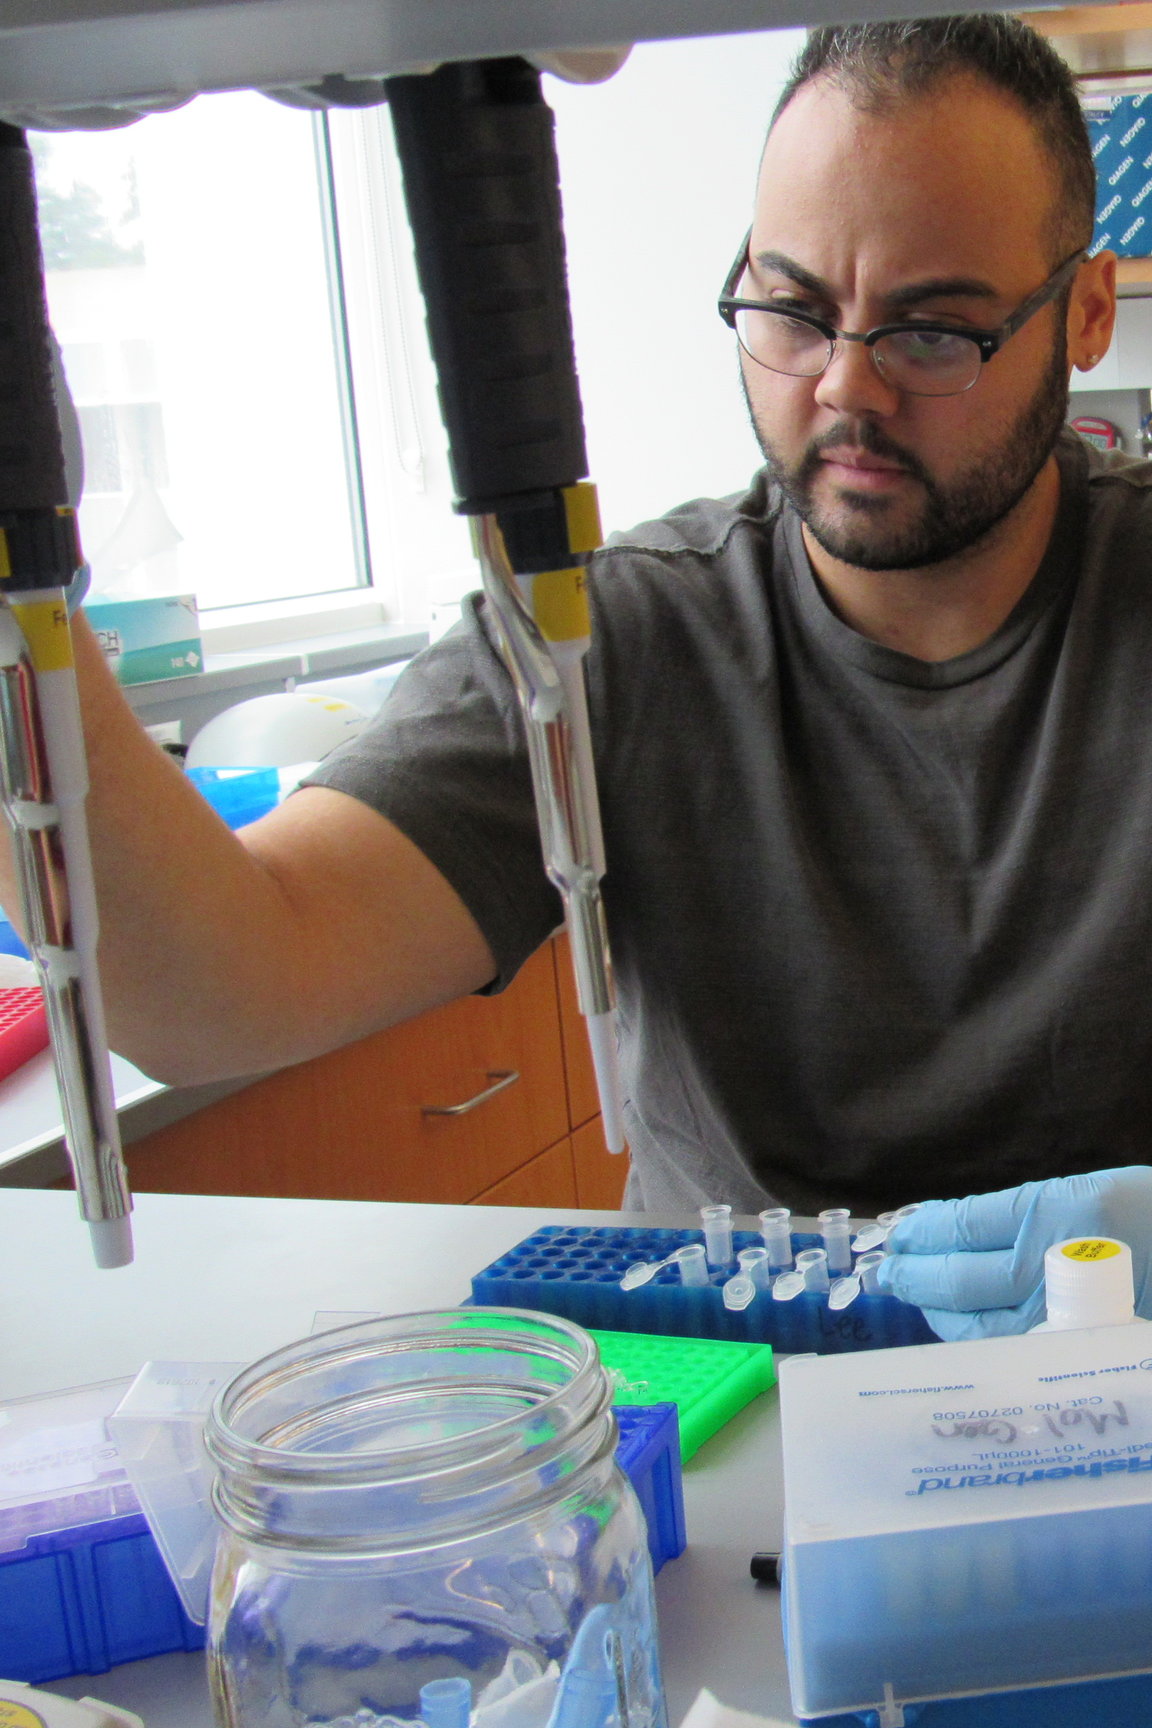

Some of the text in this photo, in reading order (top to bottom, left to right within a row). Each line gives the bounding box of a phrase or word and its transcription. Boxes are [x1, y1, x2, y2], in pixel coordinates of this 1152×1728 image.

[1108, 155, 1134, 185] QIAGEN
[1037, 1370, 1096, 1383] Scientific
[1098, 1364, 1137, 1375] Fisher
[858, 1383, 976, 1397] www.fishersci.com
[933, 1396, 1103, 1421] Cat. No. 02707508
[911, 1461, 992, 1475] Purpose
[999, 1454, 1073, 1470] General
